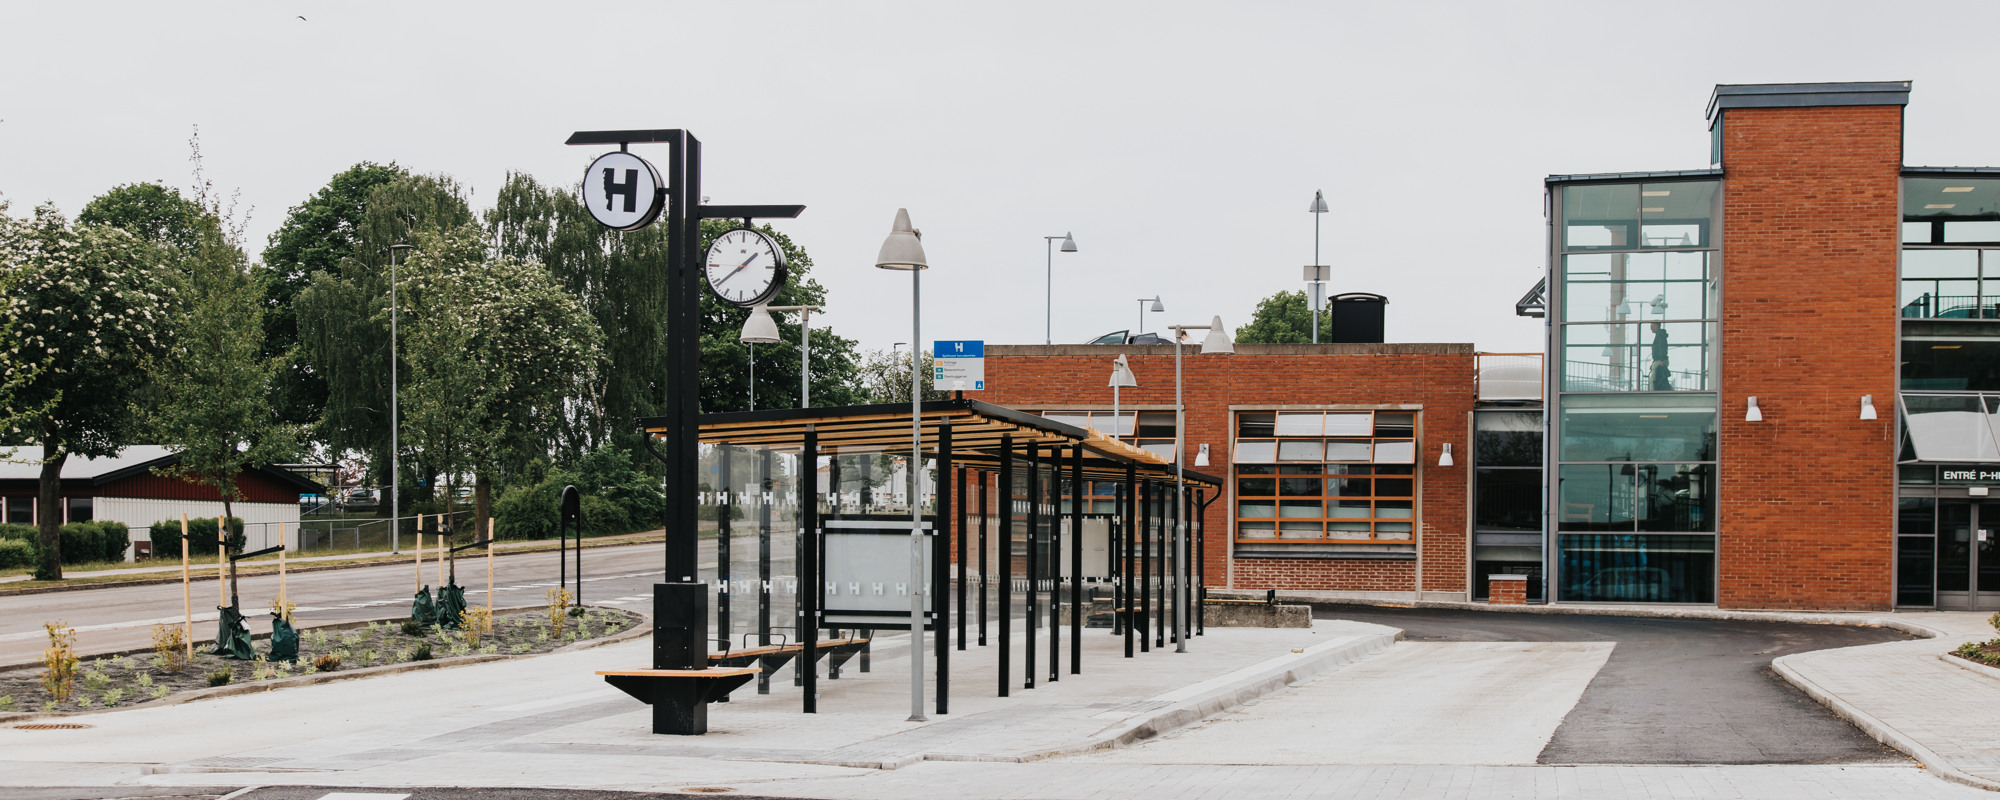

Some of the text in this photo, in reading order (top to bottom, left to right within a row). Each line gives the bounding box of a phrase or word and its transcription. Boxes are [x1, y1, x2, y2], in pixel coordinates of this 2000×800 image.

[603, 168, 638, 212] H
[955, 343, 963, 352] H
[1944, 469, 1976, 480] ENTRÉ
[717, 492, 727, 504] H
[739, 492, 750, 504] H
[762, 492, 773, 504] H
[825, 492, 837, 505] H
[717, 580, 728, 593] H
[762, 580, 773, 593] H
[825, 581, 836, 595] H
[849, 581, 860, 595] H
[872, 582, 884, 595] H
[895, 582, 907, 595] H
